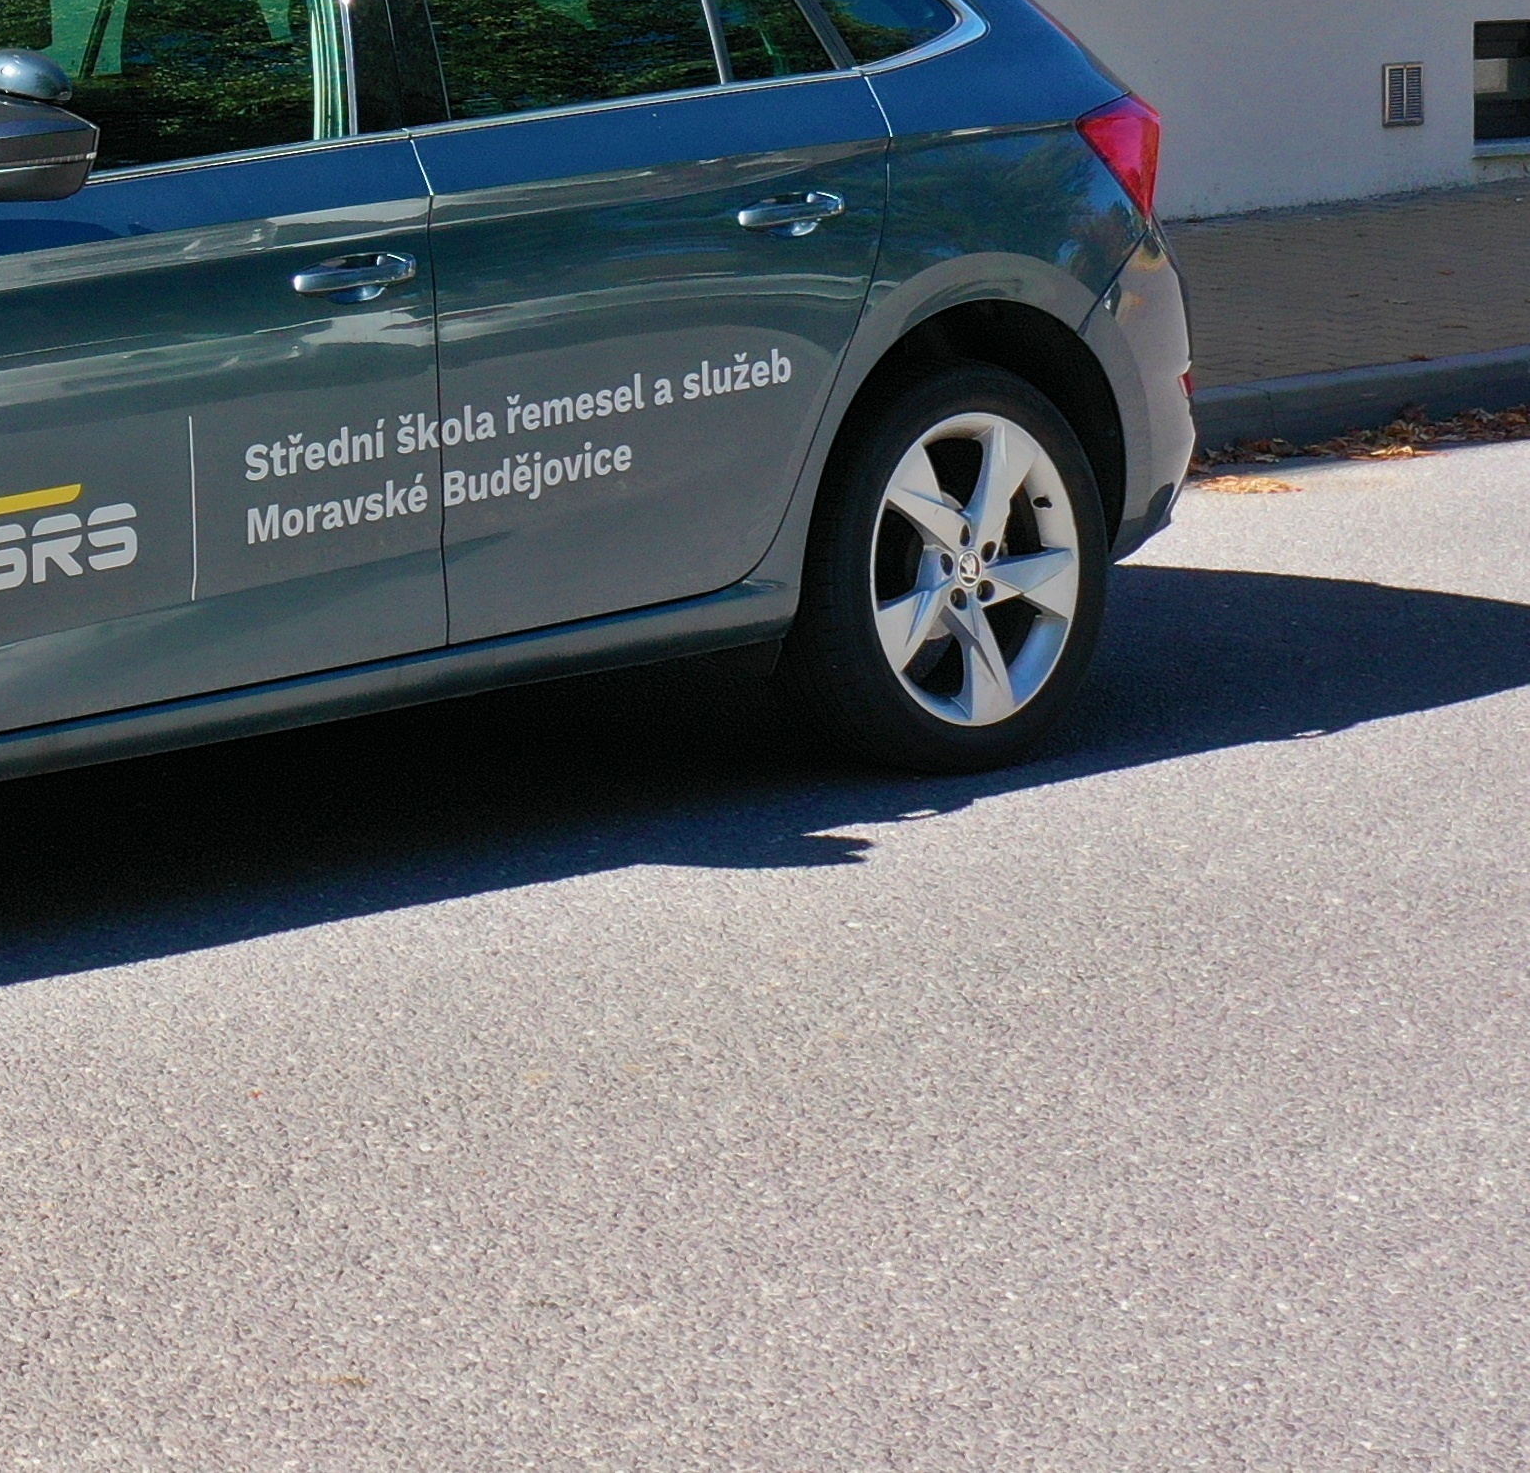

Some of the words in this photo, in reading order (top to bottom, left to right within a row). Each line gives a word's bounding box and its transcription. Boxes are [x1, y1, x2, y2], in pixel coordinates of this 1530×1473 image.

[244, 418, 386, 481] Střední
[396, 404, 497, 454] škola
[505, 372, 645, 434] řemesel
[653, 377, 674, 406] a
[682, 348, 792, 400] služeb
[246, 472, 429, 545] Moravské
[443, 441, 633, 508] Budějovice
